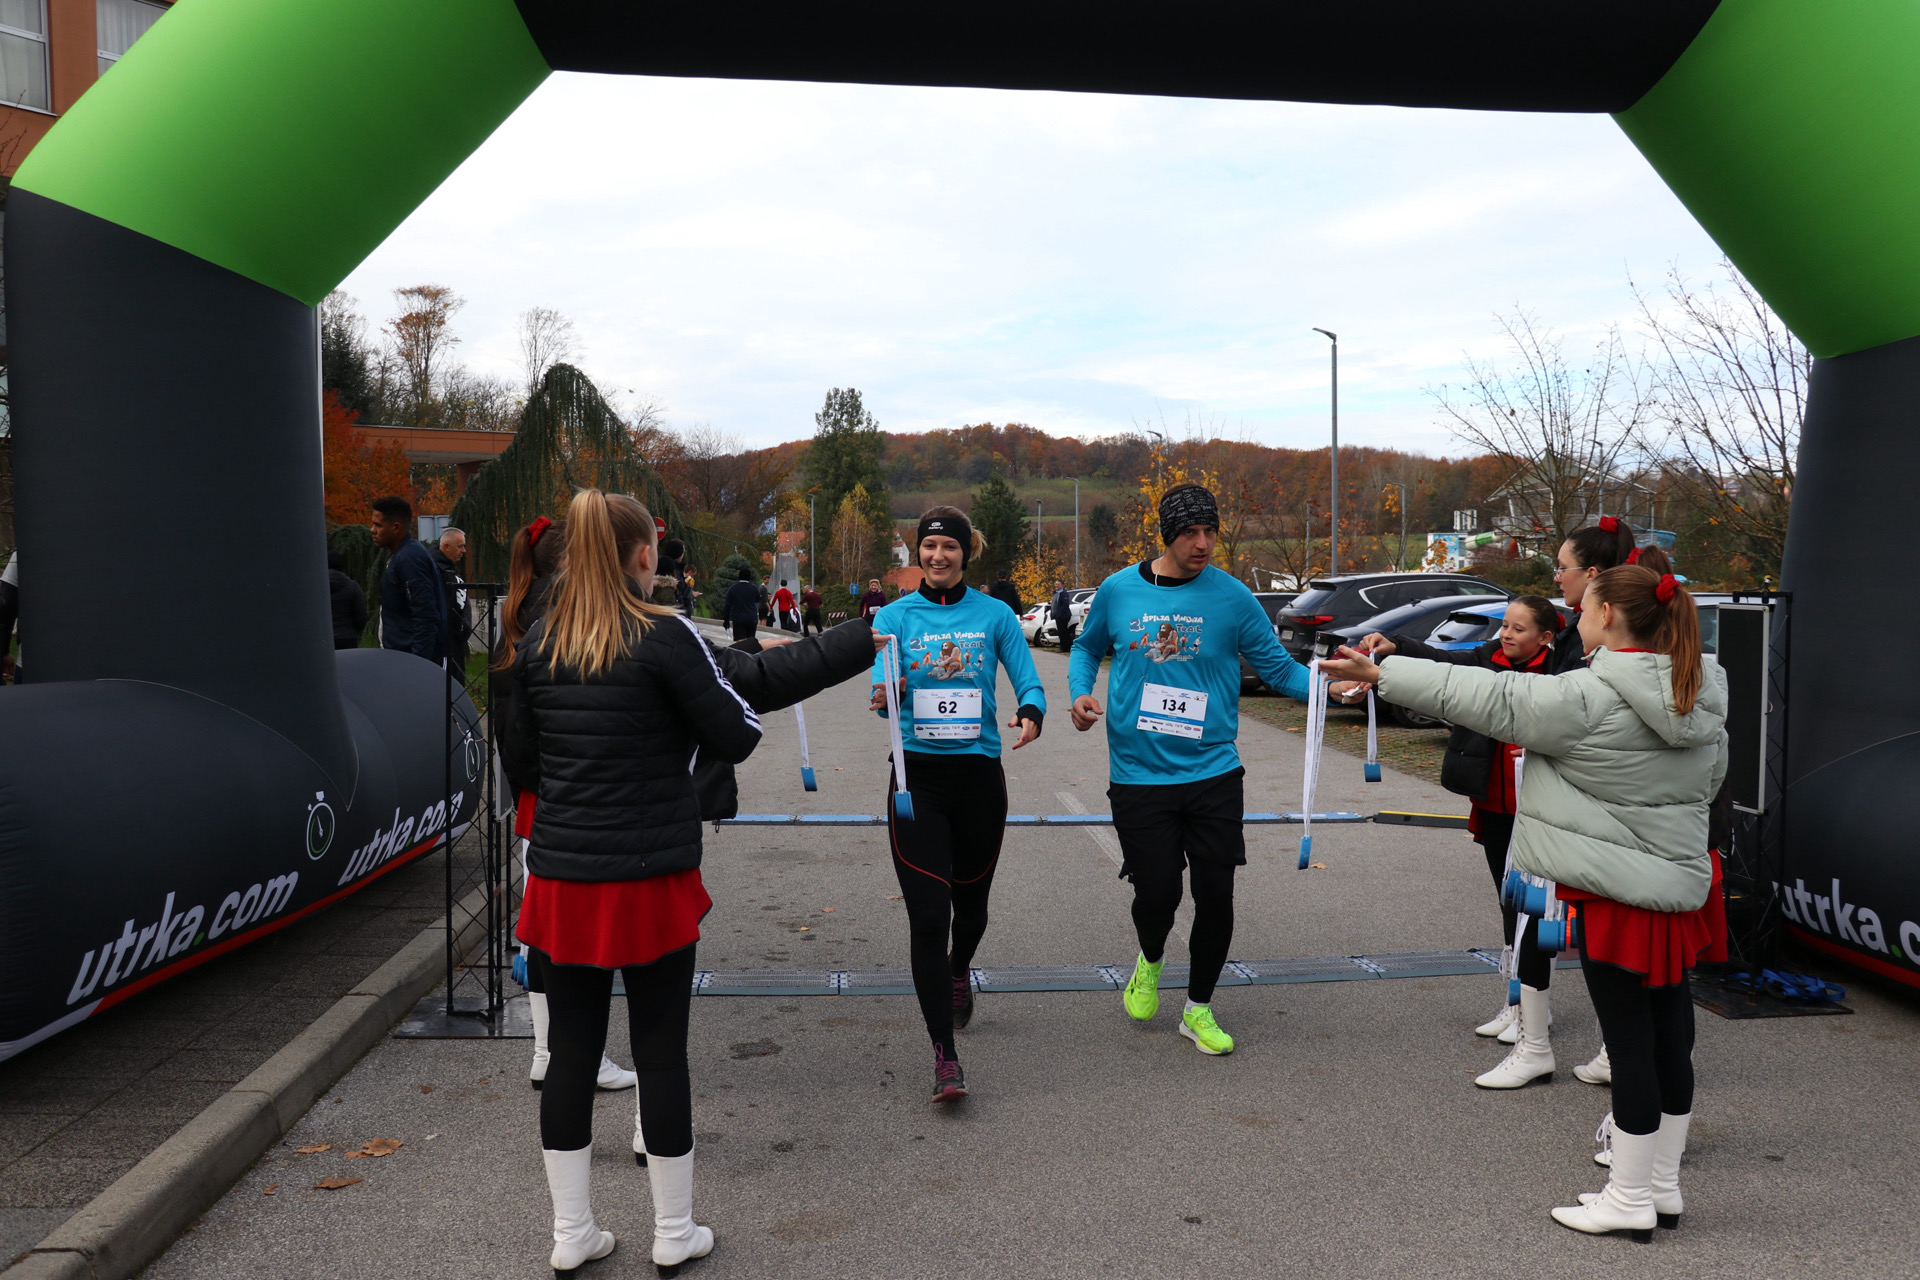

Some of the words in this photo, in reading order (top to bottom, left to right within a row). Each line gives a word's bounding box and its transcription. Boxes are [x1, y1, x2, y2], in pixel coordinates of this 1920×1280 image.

[937, 700, 957, 714] 62
[1162, 698, 1187, 714] 134
[337, 790, 464, 887] utrka.com
[66, 870, 299, 1006] utrka.com
